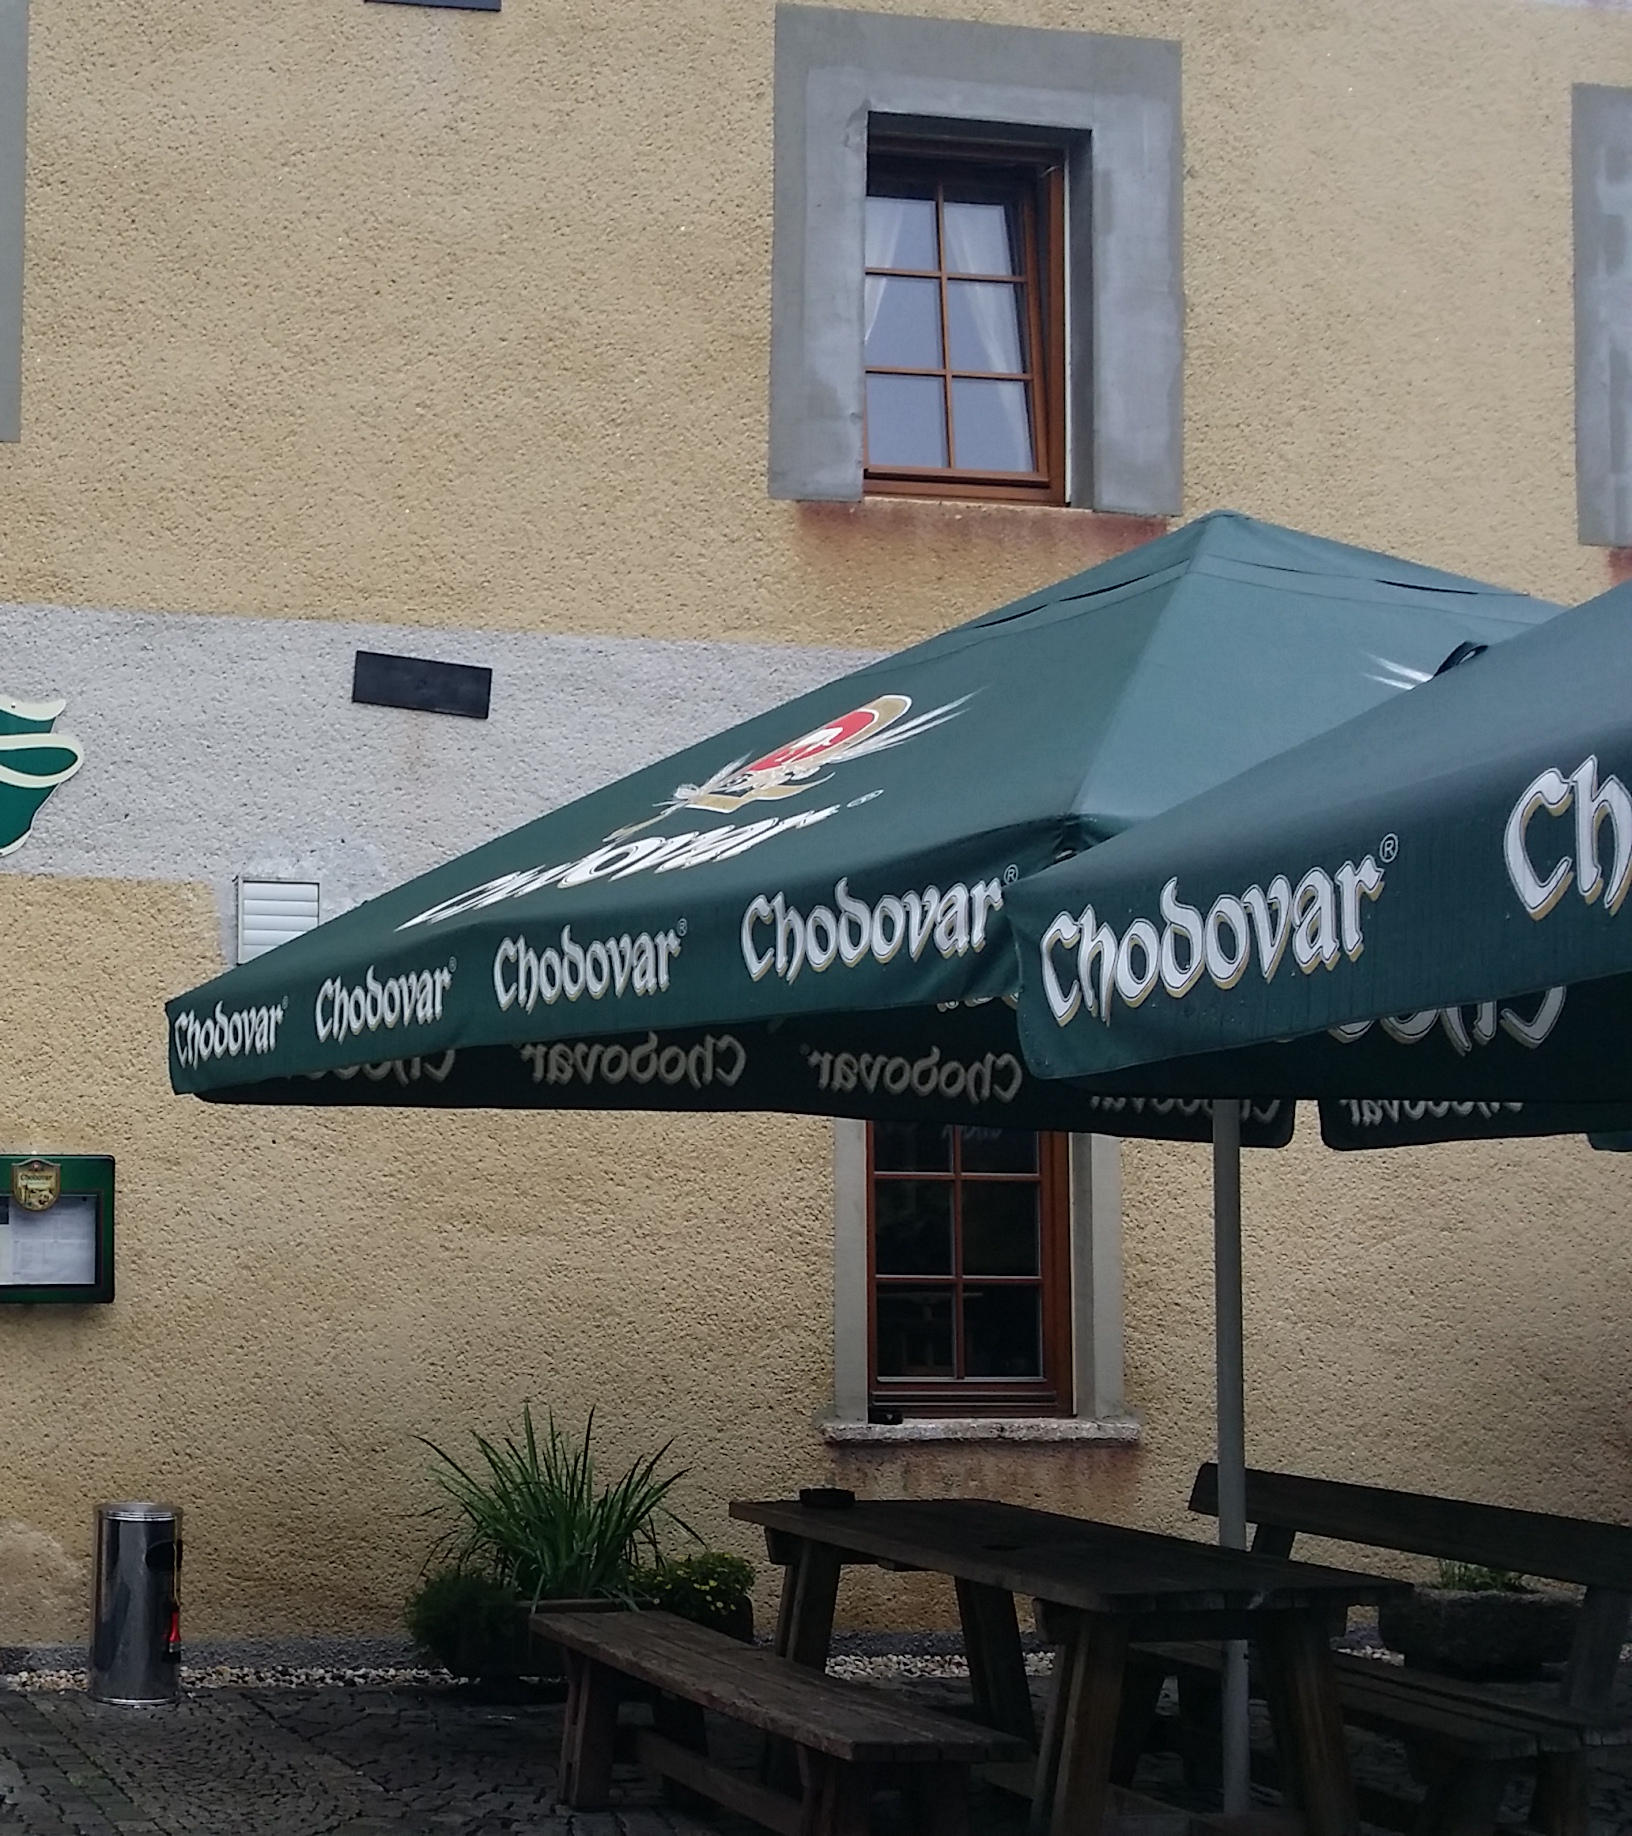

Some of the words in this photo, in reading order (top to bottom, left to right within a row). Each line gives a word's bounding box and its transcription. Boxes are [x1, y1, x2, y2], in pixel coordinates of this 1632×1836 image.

[492, 924, 683, 1013] Chodovar
[739, 876, 1004, 985] Chodovar
[1039, 855, 1385, 1027] Chodovar
[173, 1002, 284, 1069] Chodovar
[314, 964, 453, 1044] Chodovar
